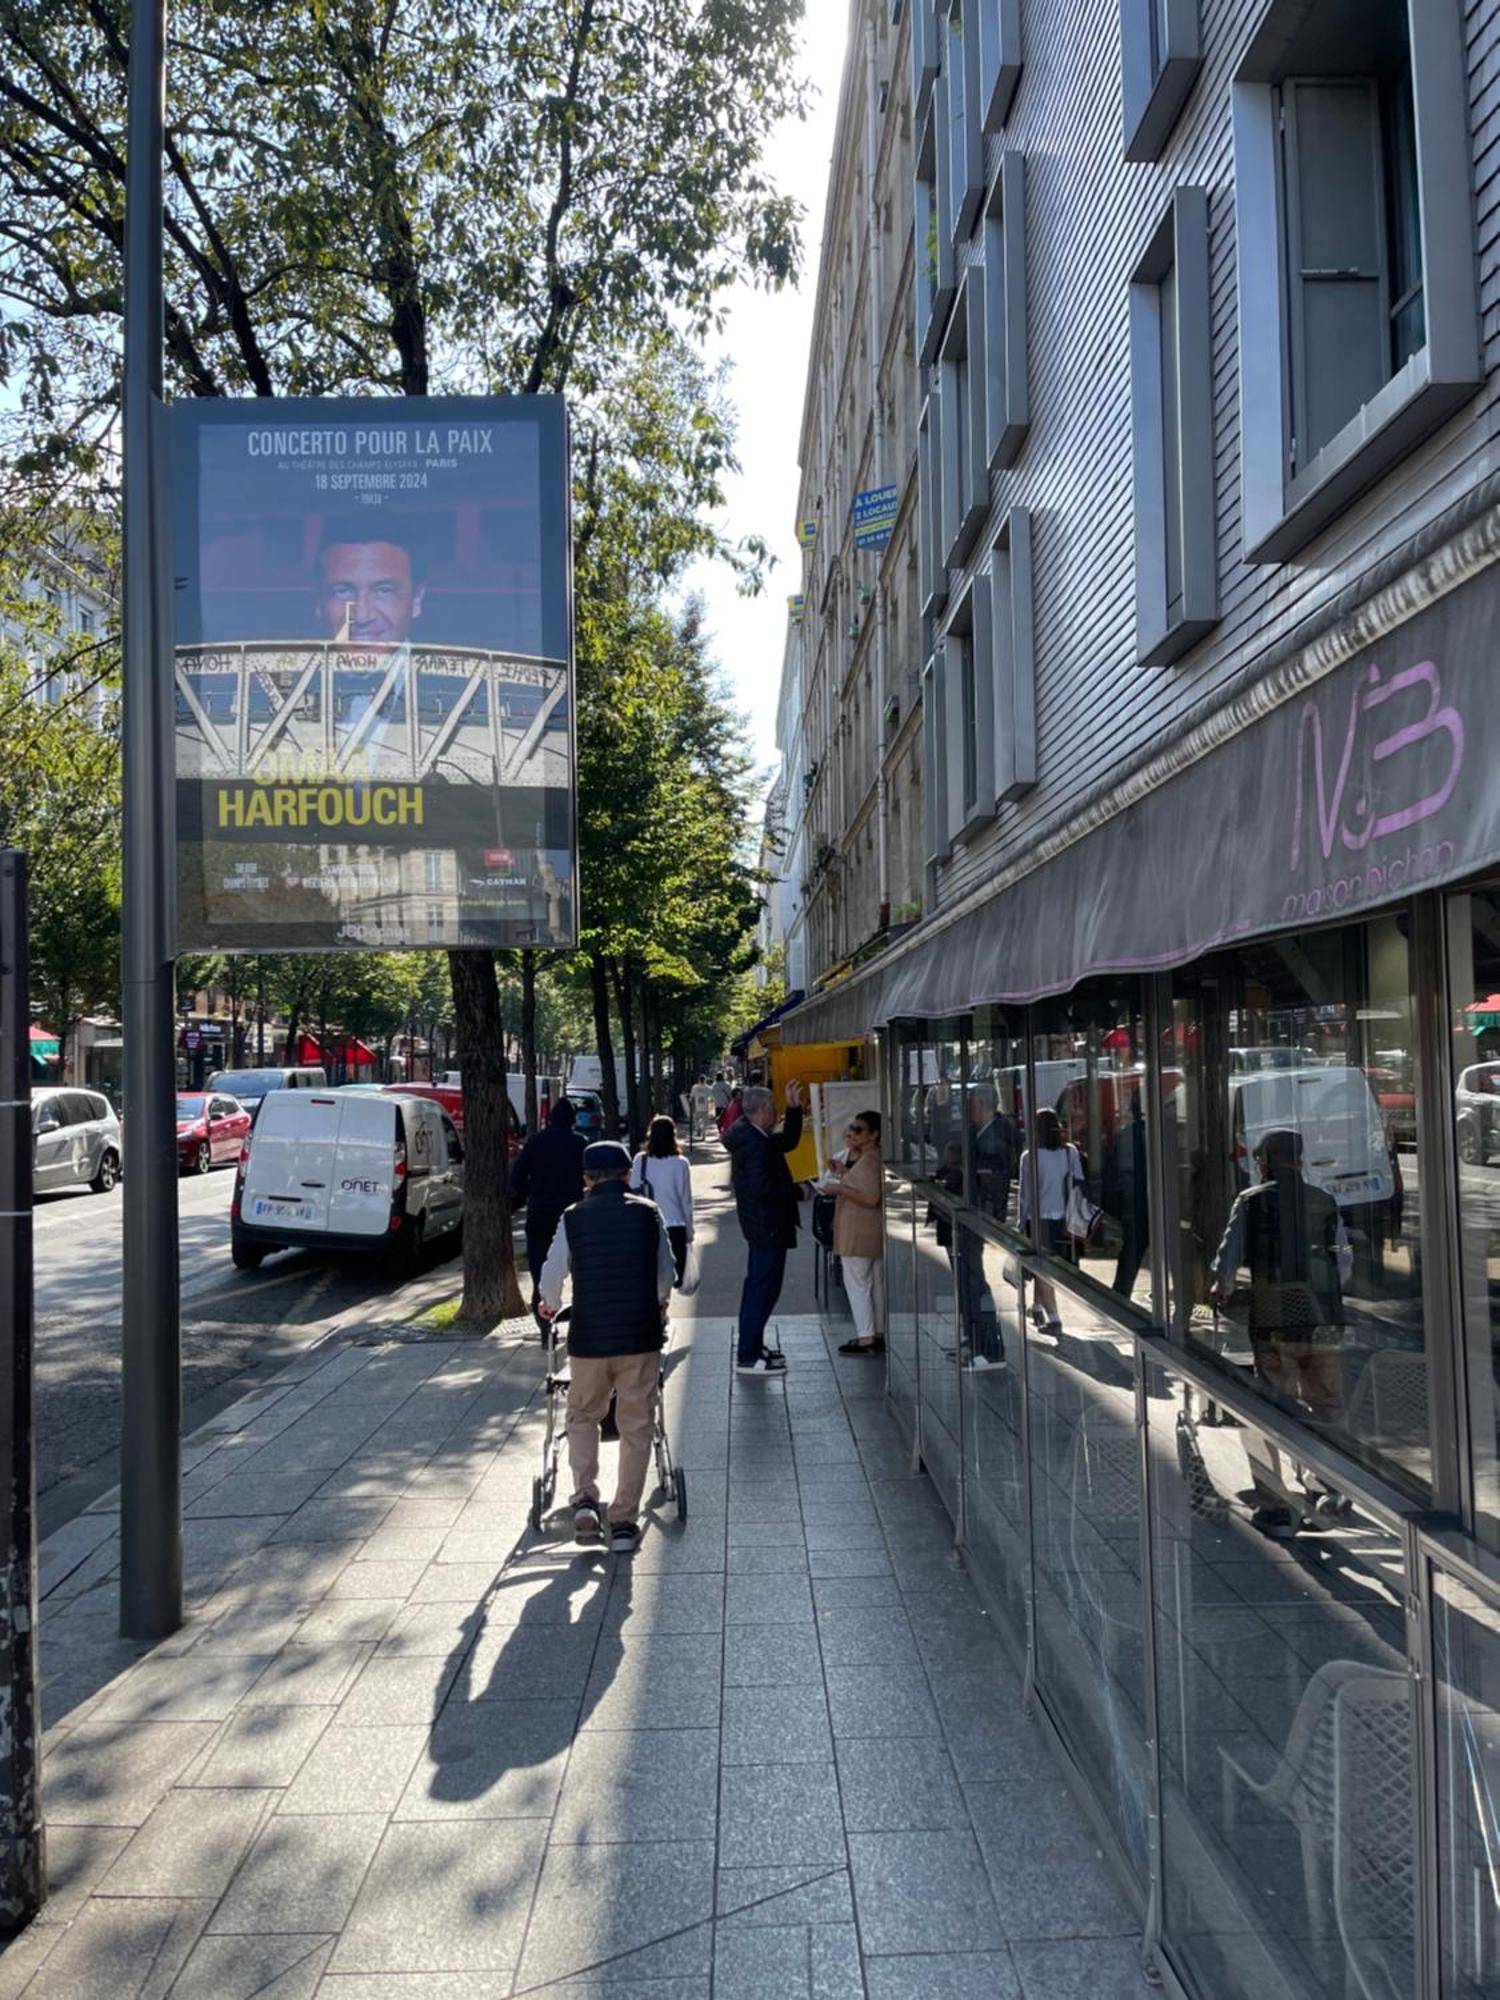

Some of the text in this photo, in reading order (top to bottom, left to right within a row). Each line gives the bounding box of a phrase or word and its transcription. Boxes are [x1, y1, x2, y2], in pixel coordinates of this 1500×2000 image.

[248, 429, 493, 456] CONCERTO POUR LA PAIX
[425, 458, 459, 468] PARIS
[315, 473, 428, 489] 18 SEPTEMBRE 2024
[218, 787, 424, 828] HARFOUCH
